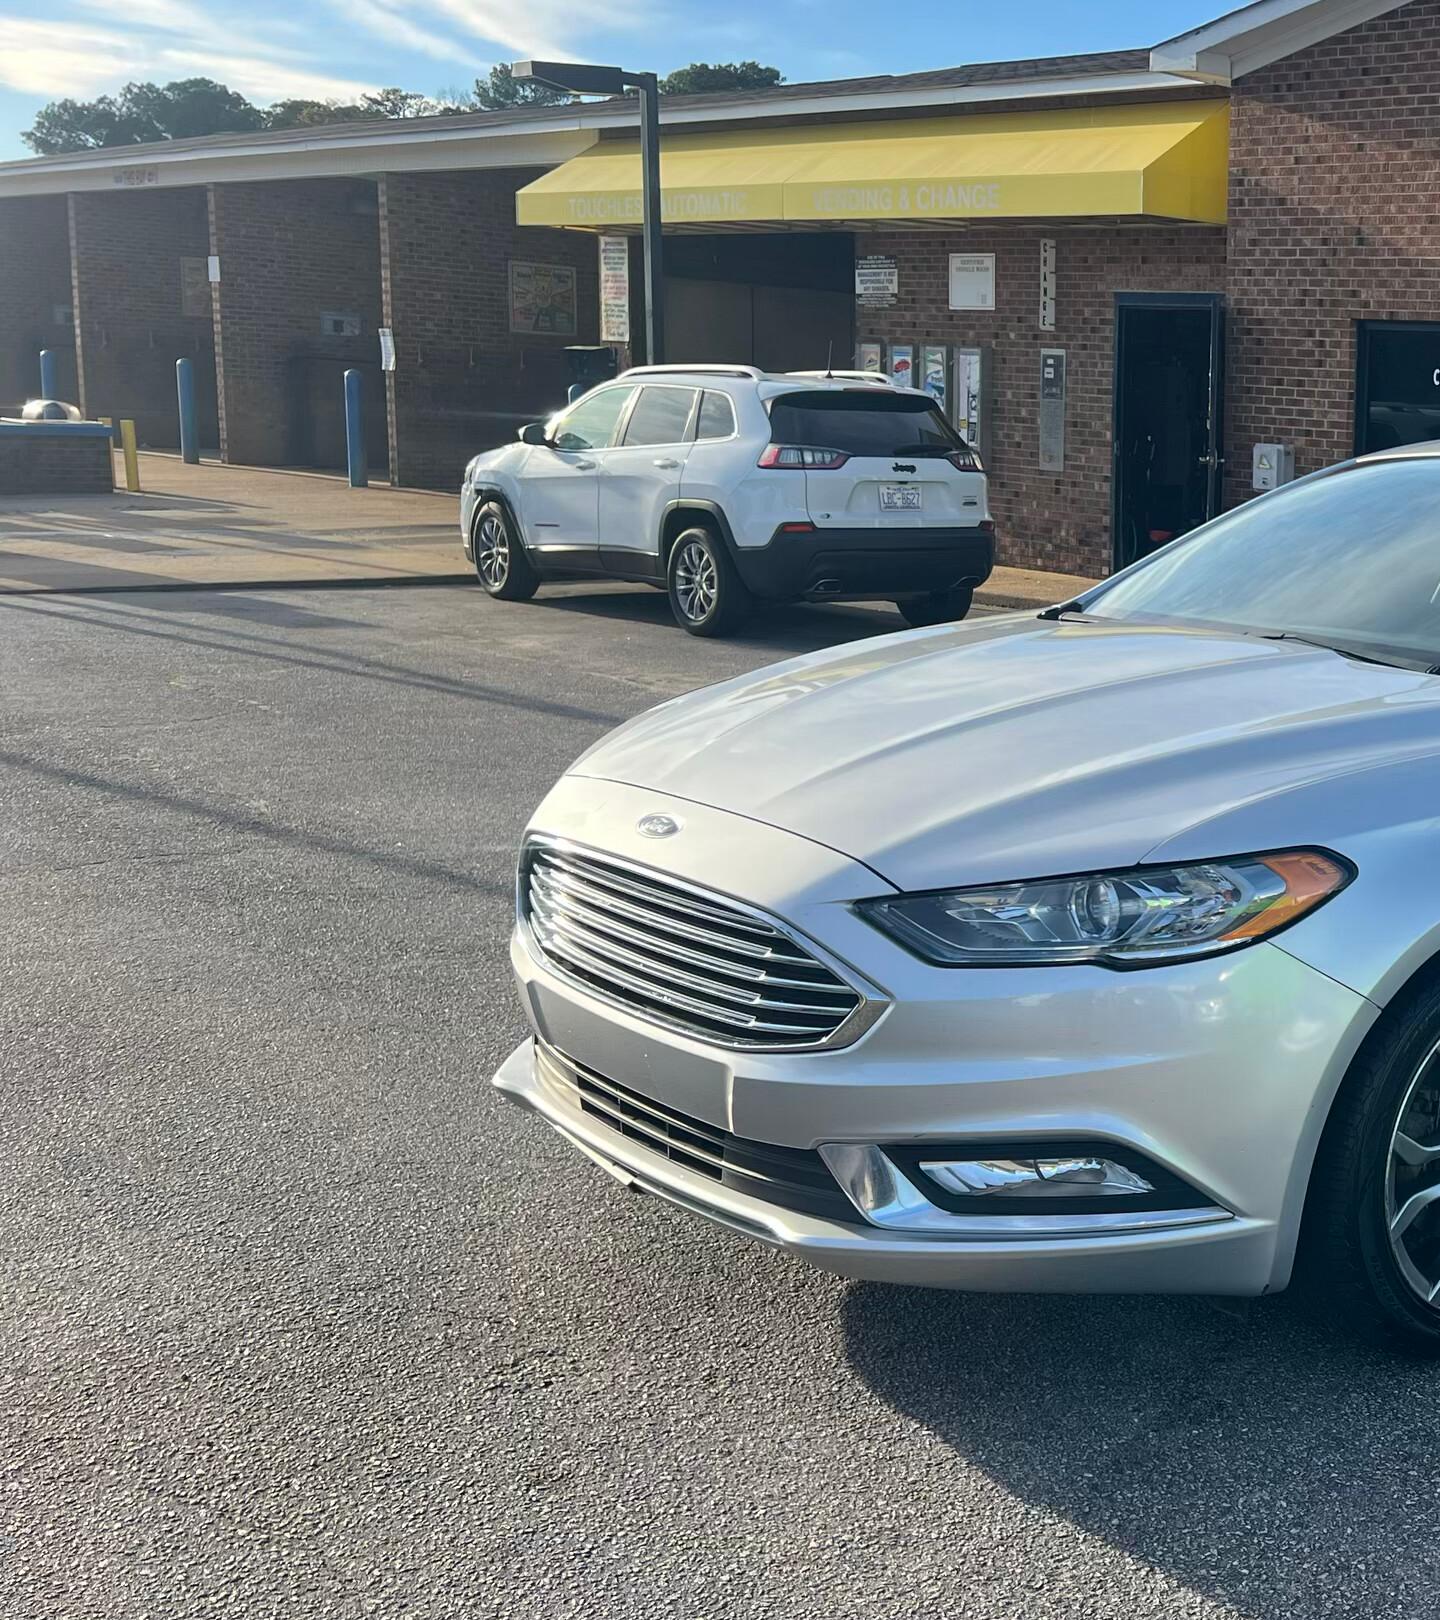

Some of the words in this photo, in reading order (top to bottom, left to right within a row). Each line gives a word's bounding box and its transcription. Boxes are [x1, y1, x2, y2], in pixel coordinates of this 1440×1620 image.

[569, 196, 646, 218] TOUCHLES
[813, 188, 893, 212] VENDING
[900, 187, 910, 210] &
[916, 183, 1000, 210] CHANGE
[1041, 242, 1049, 327] CHANGE
